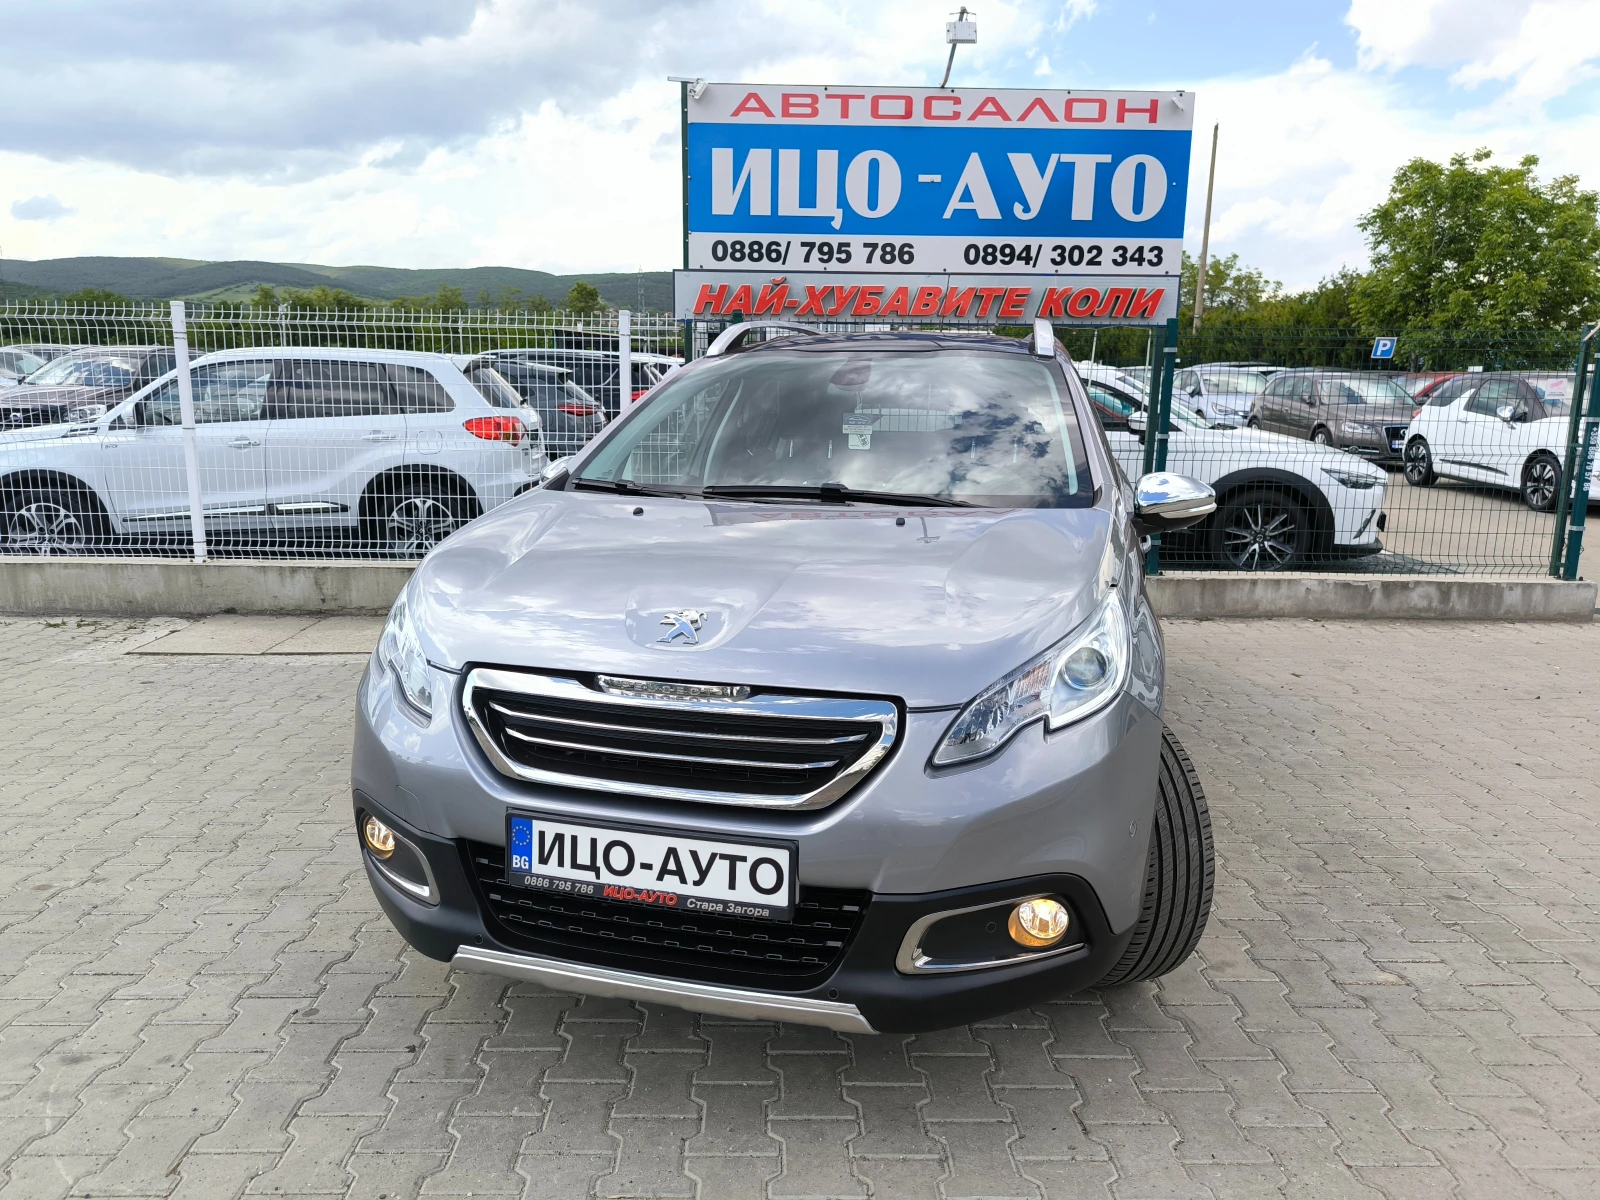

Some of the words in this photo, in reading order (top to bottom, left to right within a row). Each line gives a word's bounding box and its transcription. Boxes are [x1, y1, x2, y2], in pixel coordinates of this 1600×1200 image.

[730, 92, 1159, 124] АВТОСАЛОН
[711, 240, 792, 265] 0886/
[800, 241, 852, 264] 795
[862, 242, 915, 265] 786
[963, 243, 1043, 268] 0894/
[1050, 244, 1103, 267] 302
[1111, 245, 1164, 267] 343
[692, 276, 1032, 317] НАЙ-ХУБАВИТЕ
[1035, 286, 1166, 319] КОЛИ
[1376, 340, 1391, 356] P
[512, 855, 530, 870] BG
[537, 830, 785, 896] ИЦО-АУТО
[524, 876, 550, 888] 0886
[552, 880, 572, 891] 795
[574, 883, 594, 895] 786
[603, 885, 678, 906] ИЦО-АУТО
[686, 898, 724, 913] Стара
[726, 902, 770, 917] Загора
